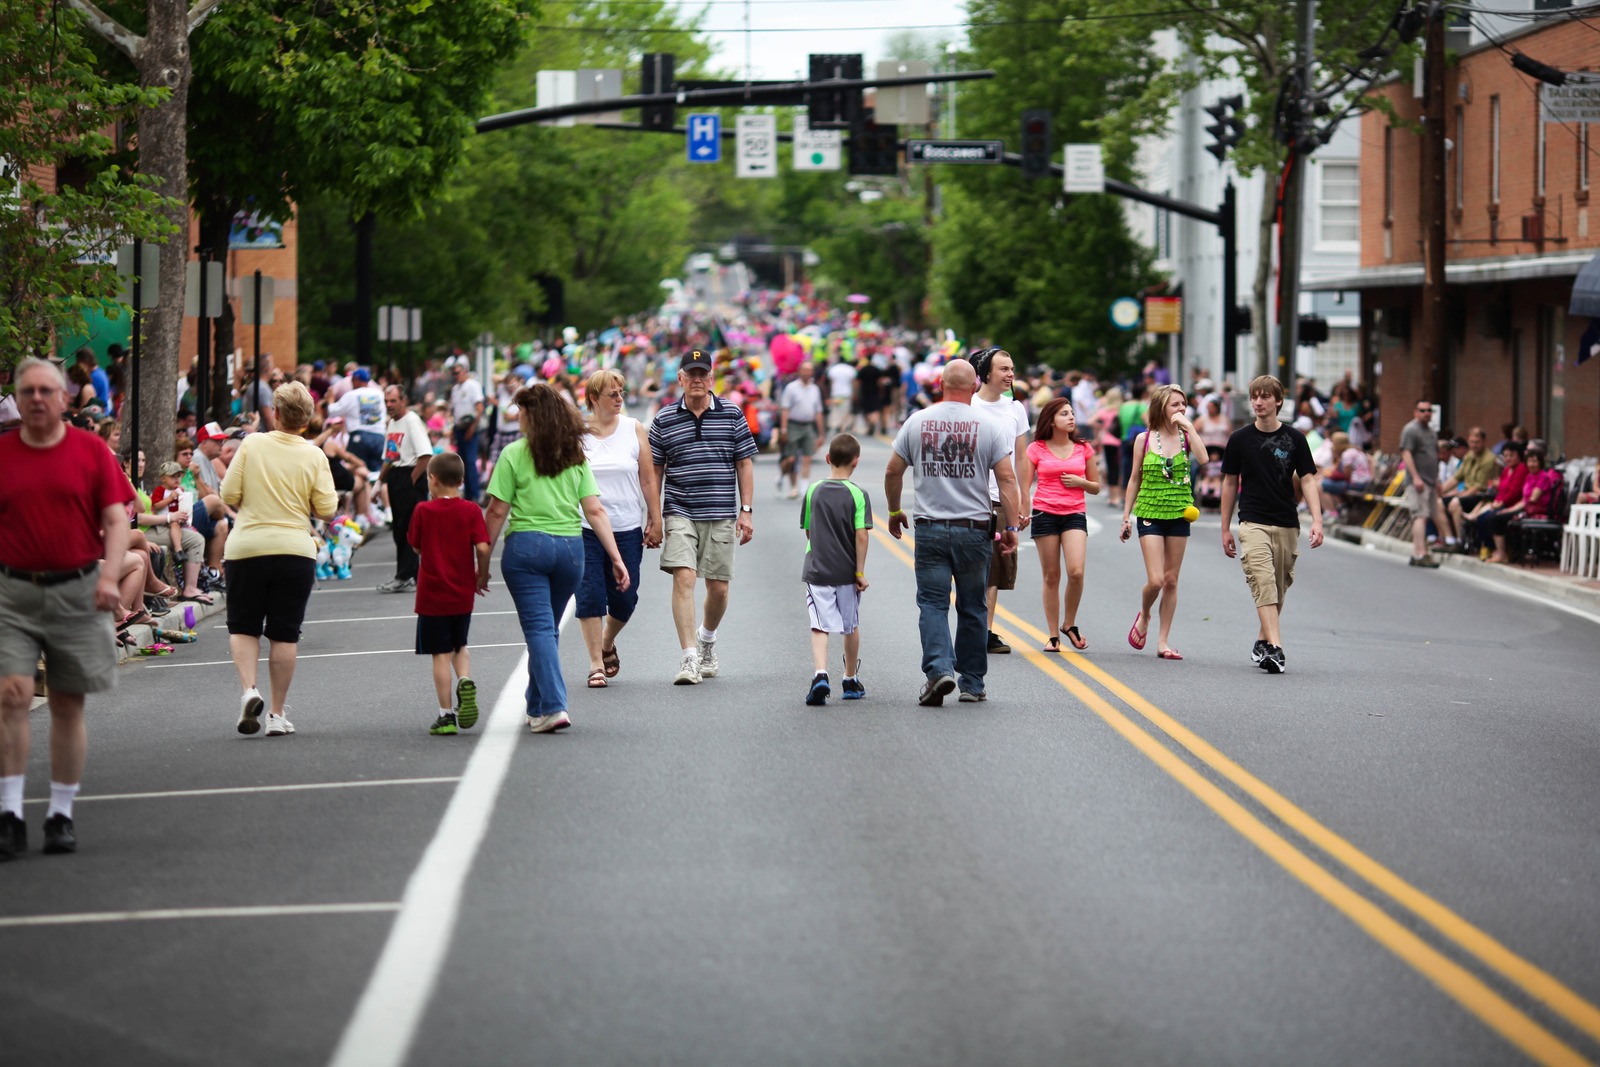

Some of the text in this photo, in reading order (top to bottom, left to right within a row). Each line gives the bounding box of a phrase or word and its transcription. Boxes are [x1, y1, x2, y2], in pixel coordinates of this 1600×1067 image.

[693, 118, 715, 142] H
[693, 351, 701, 360] P
[921, 420, 980, 433] FIELDS DON'T
[921, 432, 978, 463] PLOW
[922, 463, 976, 478] THEMSELVES
